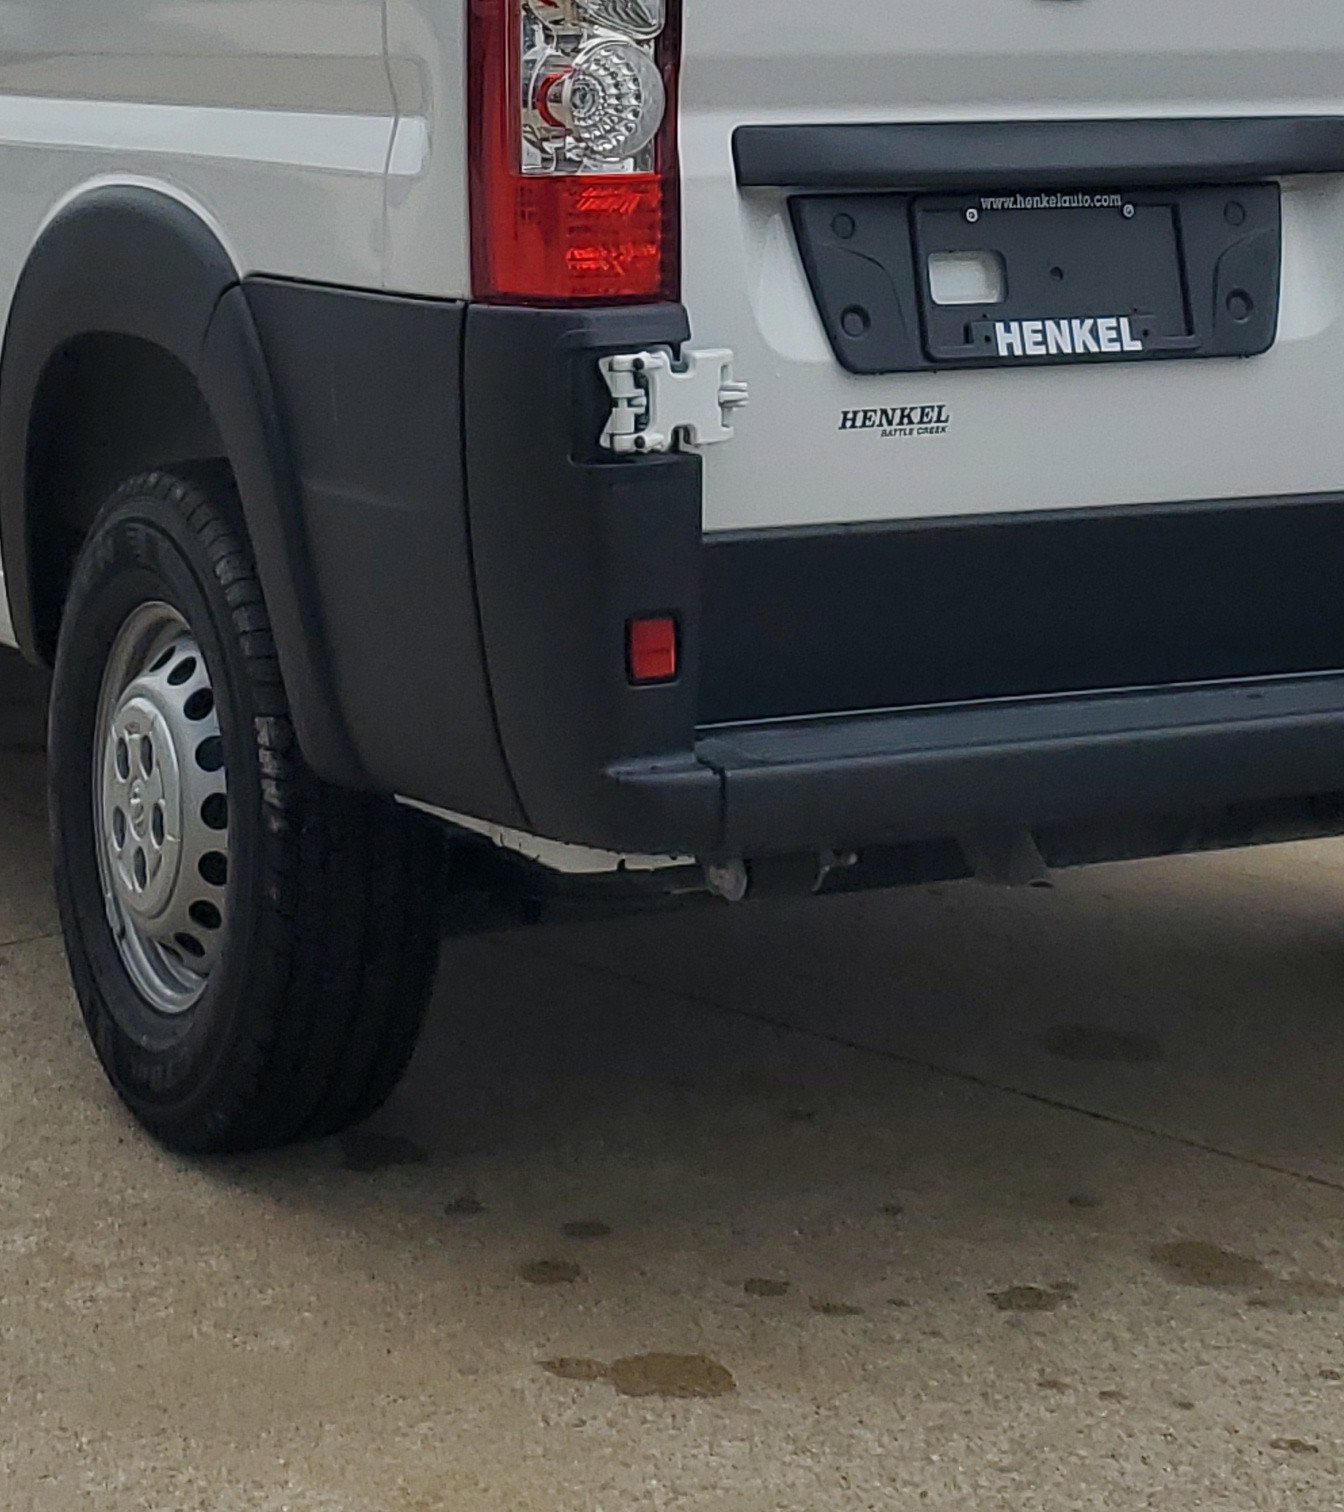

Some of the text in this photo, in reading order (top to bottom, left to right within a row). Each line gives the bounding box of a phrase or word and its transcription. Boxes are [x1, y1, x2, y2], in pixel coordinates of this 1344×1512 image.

[980, 192, 1123, 209] www.henkelauto.com
[994, 316, 1144, 357] HENKEL
[838, 404, 950, 430] HENKEL
[880, 425, 948, 438] BATTLE CREEK
